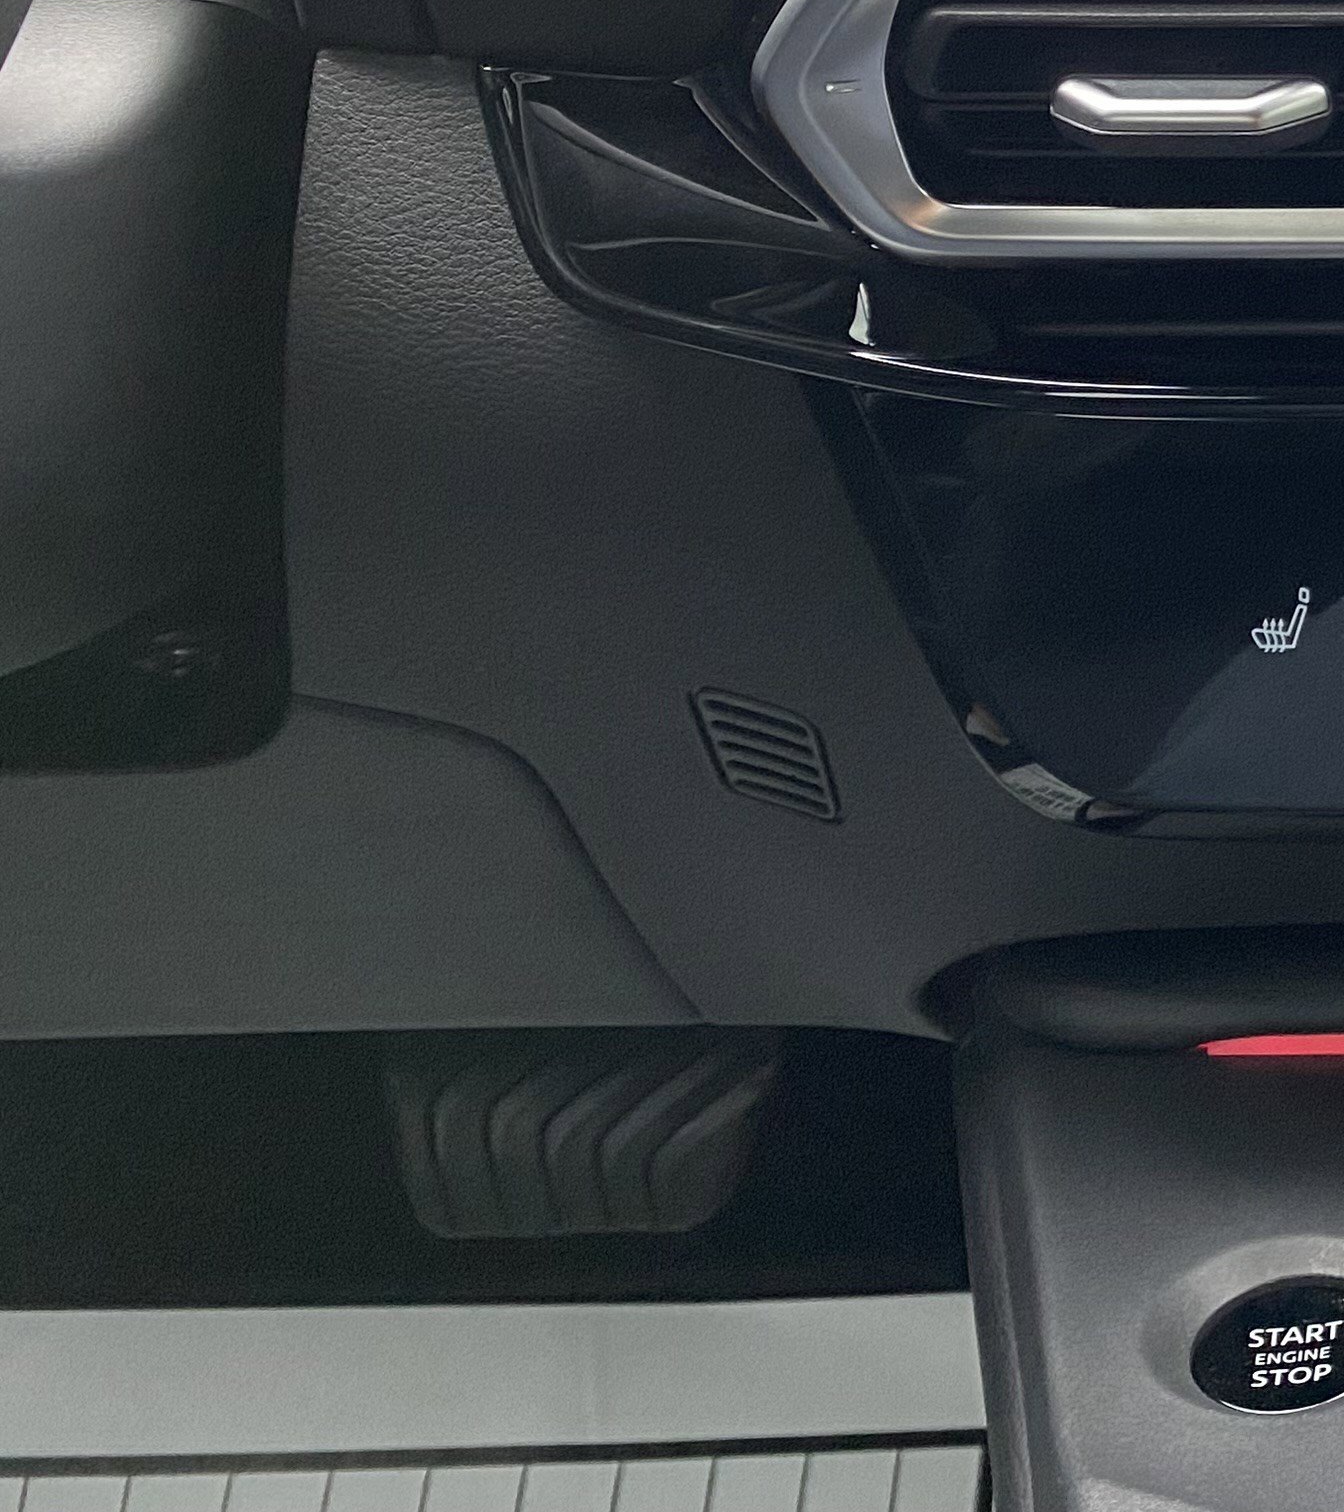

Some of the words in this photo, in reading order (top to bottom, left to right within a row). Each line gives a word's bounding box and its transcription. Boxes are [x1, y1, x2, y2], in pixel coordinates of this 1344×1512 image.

[1247, 1319, 1344, 1349] START
[1254, 1345, 1332, 1367] ENGINE
[1250, 1362, 1333, 1388] STOP
